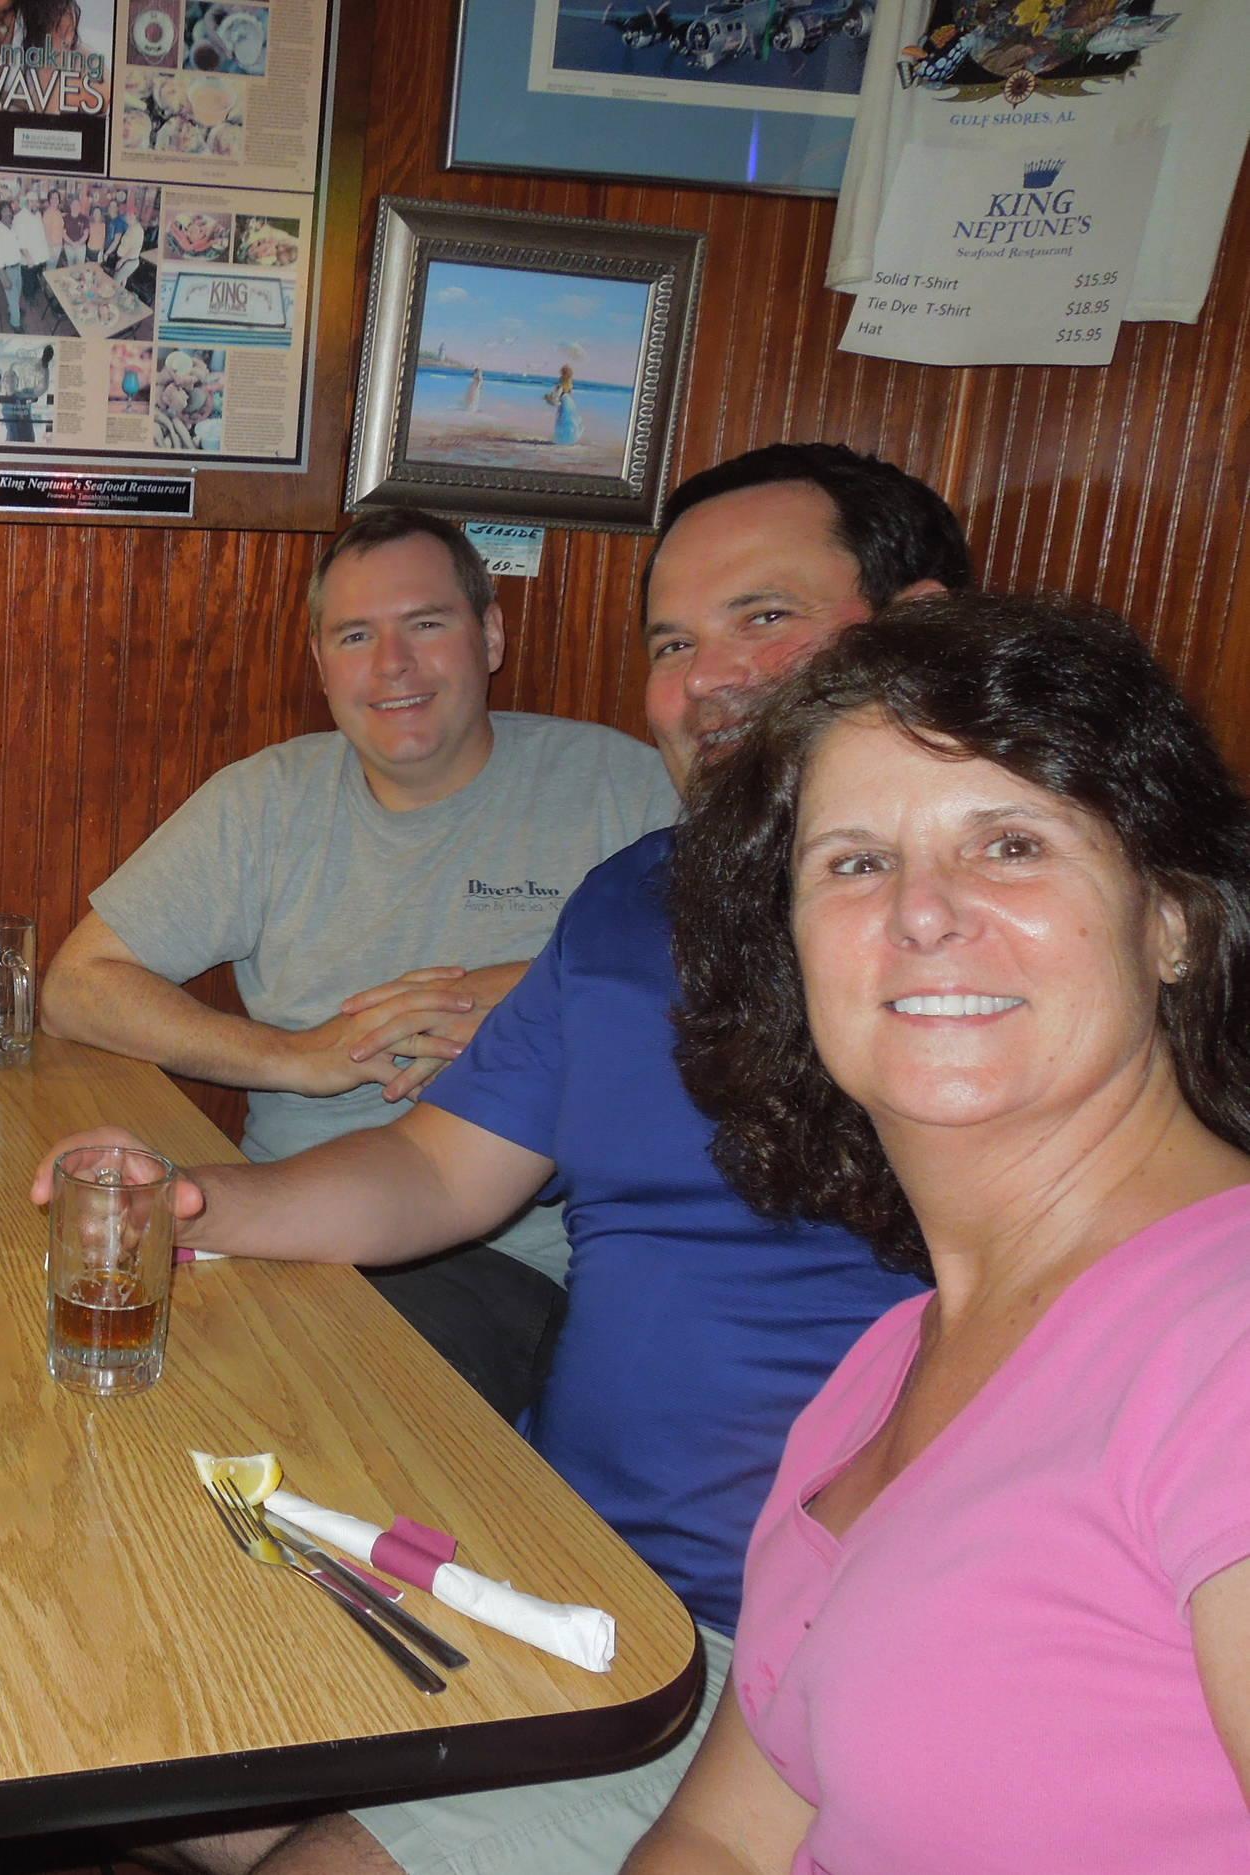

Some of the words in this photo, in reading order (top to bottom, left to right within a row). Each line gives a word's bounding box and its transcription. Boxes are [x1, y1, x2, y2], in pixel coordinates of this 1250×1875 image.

[0, 33, 104, 81] making
[950, 113, 991, 128] GULF
[1056, 111, 1076, 124] AL
[984, 189, 1076, 218] KING
[952, 215, 1092, 244] NEPTUNE'S
[956, 247, 1005, 260] Seafood
[1008, 246, 1074, 259] Restaurant
[874, 271, 910, 286] Solid
[913, 275, 959, 290] T-Shirt
[1074, 271, 1119, 288] $15.95
[210, 280, 248, 305] KING
[867, 297, 887, 310] Tie
[891, 299, 917, 315] Dye
[926, 302, 971, 317] T-Shirt
[1065, 299, 1110, 316] $18.95
[858, 322, 883, 335] Hat
[1056, 327, 1102, 342] $15.95
[0, 476, 25, 491] King
[27, 478, 81, 492] Neptune's
[83, 480, 127, 493] Seafood
[129, 482, 187, 494] Restaurant
[469, 525, 542, 539] SEASIDE
[468, 879, 523, 896] Divers
[525, 879, 560, 896] Two
